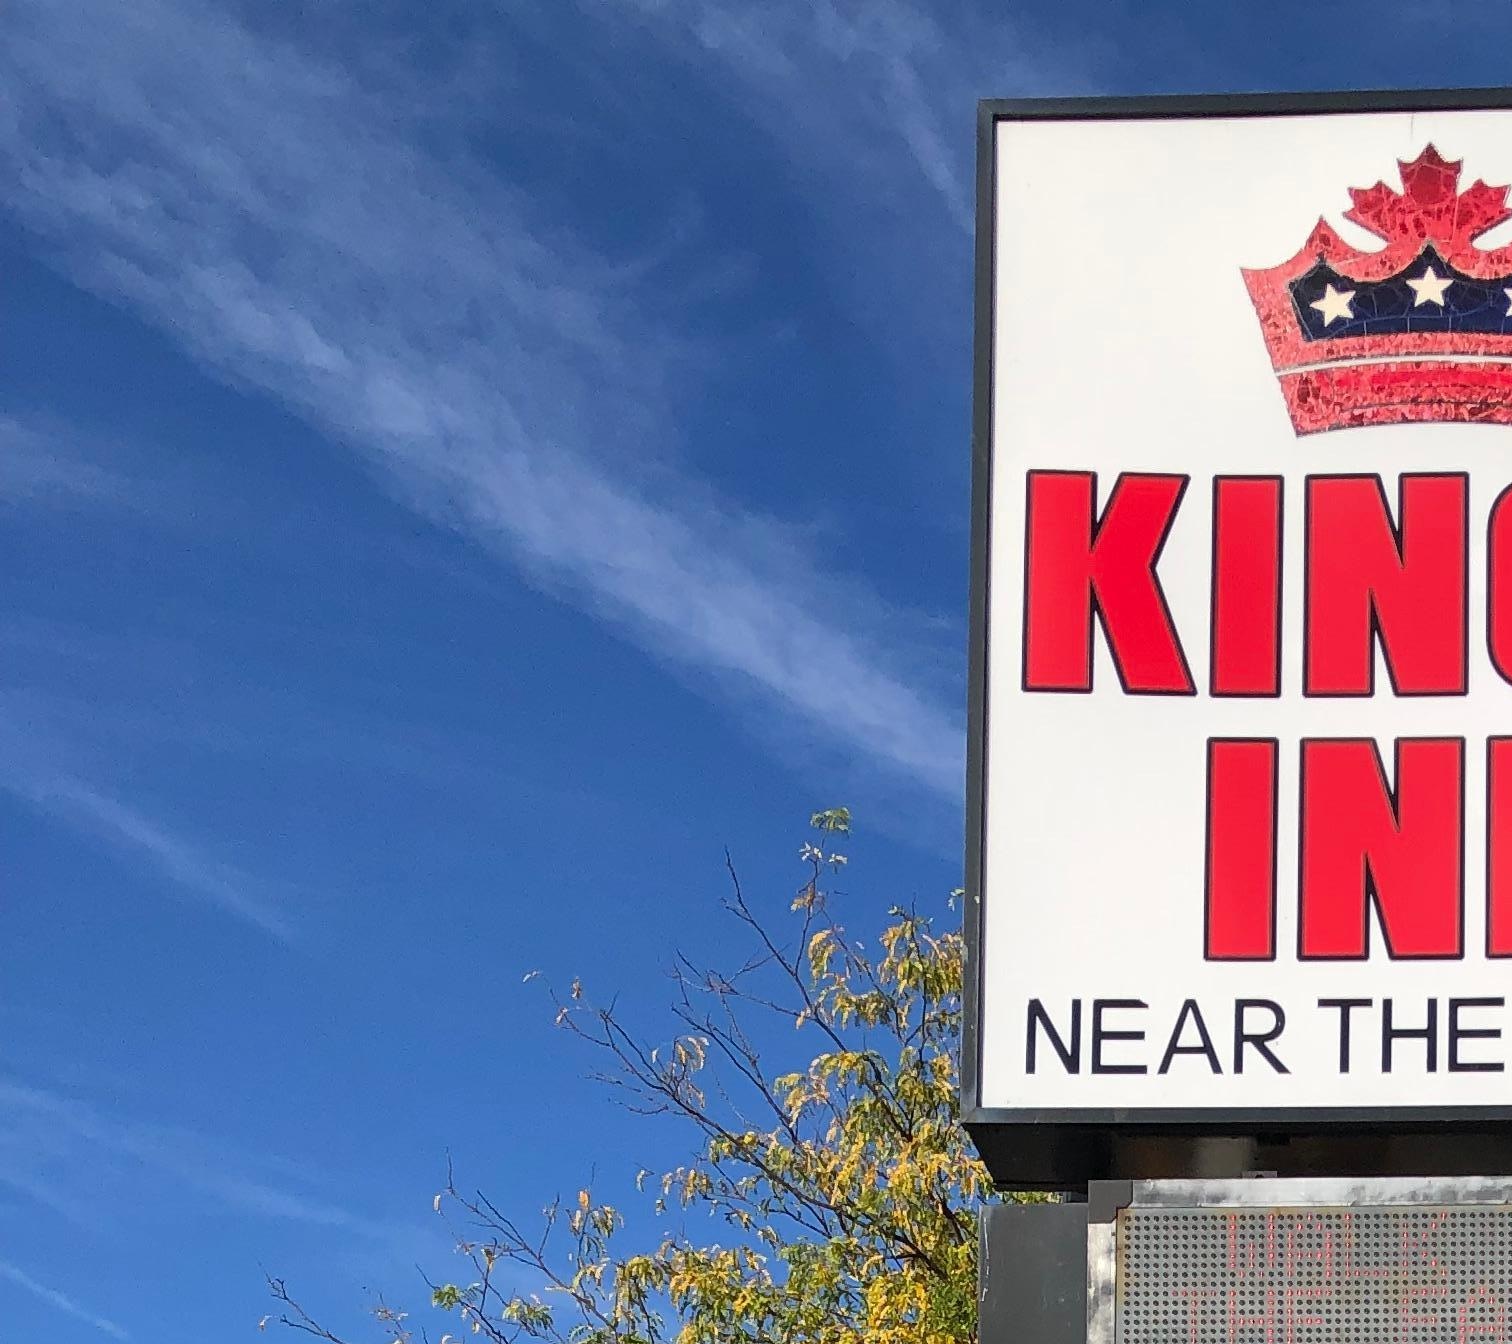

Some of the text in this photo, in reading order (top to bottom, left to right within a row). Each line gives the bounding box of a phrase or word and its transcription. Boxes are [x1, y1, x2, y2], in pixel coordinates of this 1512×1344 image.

[1024, 997, 1292, 1075] NEAR
[1318, 996, 1506, 1074] THE
[1228, 1211, 1449, 1279] WALK
